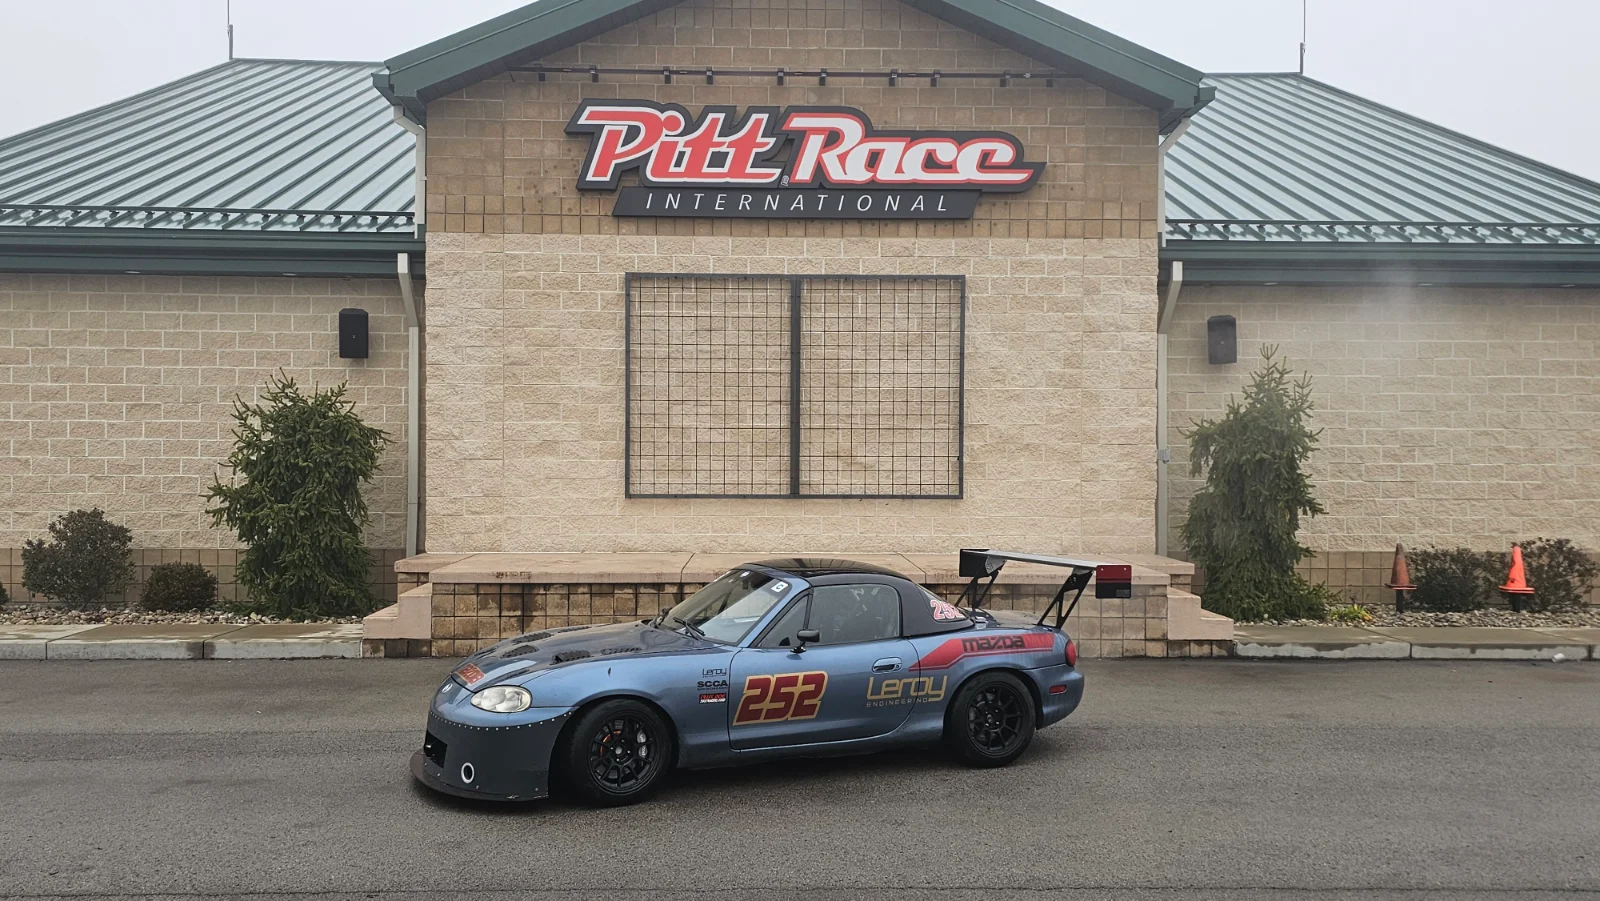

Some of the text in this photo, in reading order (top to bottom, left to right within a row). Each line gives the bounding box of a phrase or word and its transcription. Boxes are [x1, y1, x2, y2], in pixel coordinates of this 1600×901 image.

[579, 105, 1036, 185] Pitt Race
[646, 192, 950, 212] INTERNATIONAL
[732, 670, 829, 726] 252
[866, 675, 948, 702] Leroy
[866, 697, 930, 708] ENGINEERING
